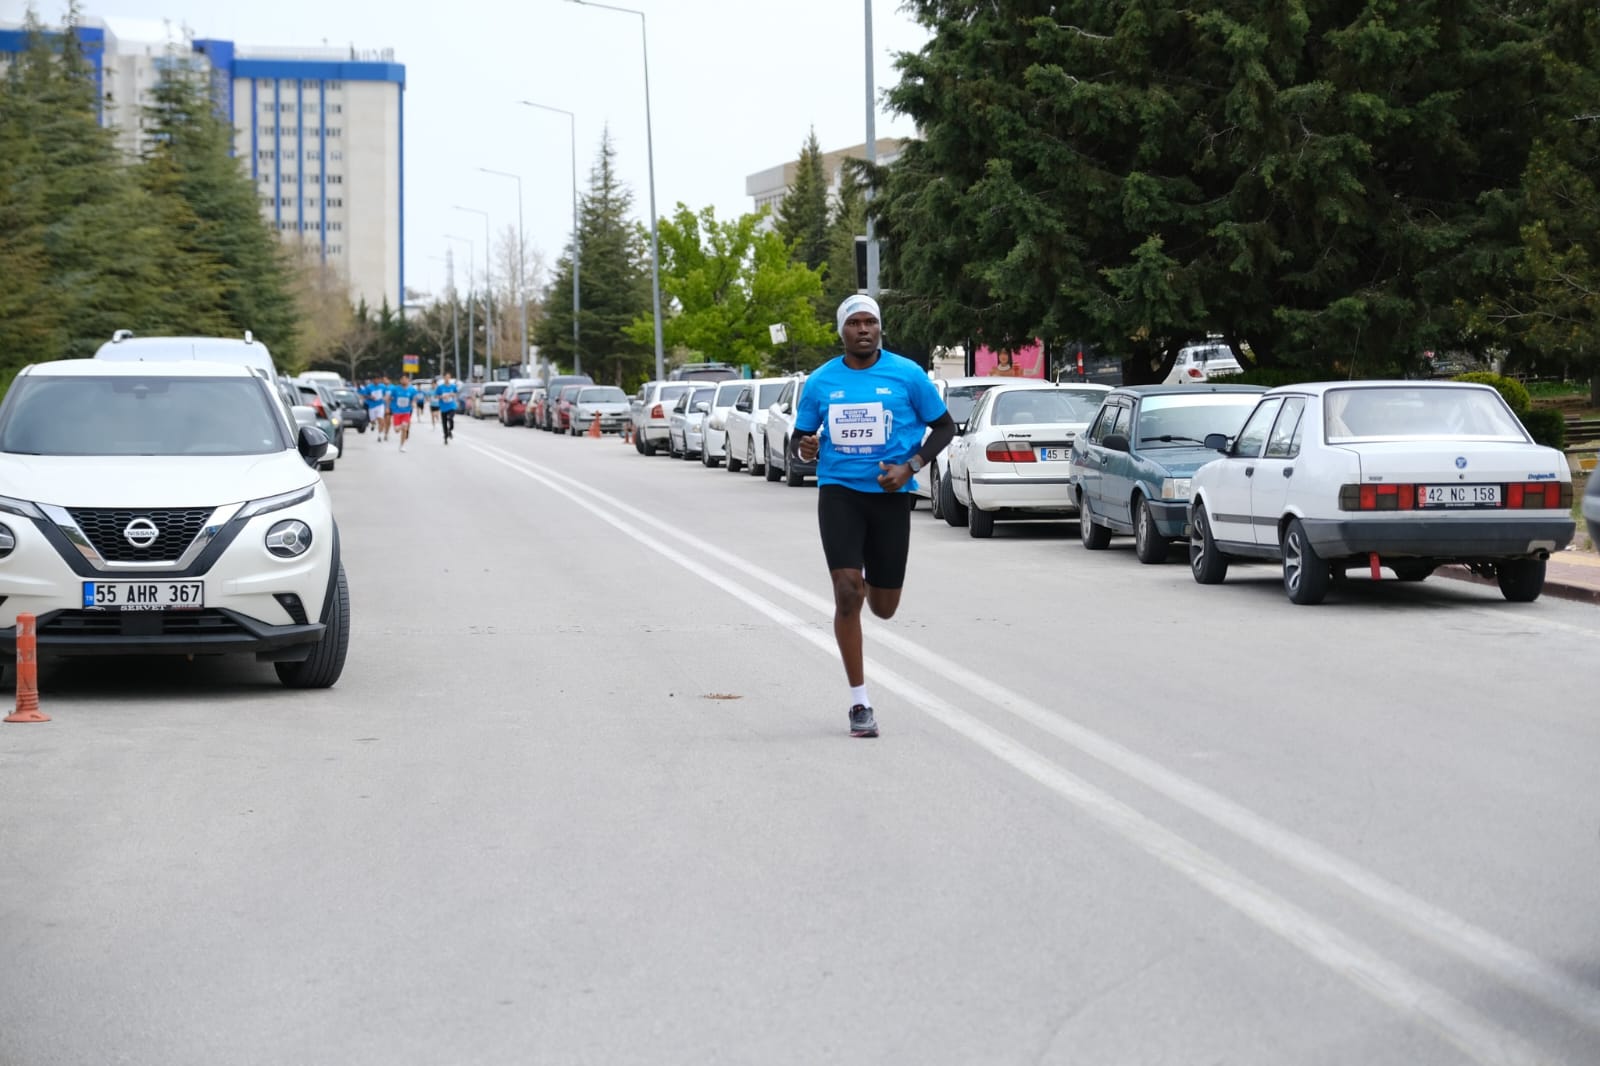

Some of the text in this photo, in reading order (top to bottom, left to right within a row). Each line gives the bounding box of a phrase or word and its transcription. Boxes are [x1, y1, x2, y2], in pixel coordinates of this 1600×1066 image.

[841, 428, 873, 438] 5675
[1047, 450, 1058, 459] 45
[1428, 488, 1495, 501] 42 NC 158
[96, 585, 200, 603] 55 AHR 367
